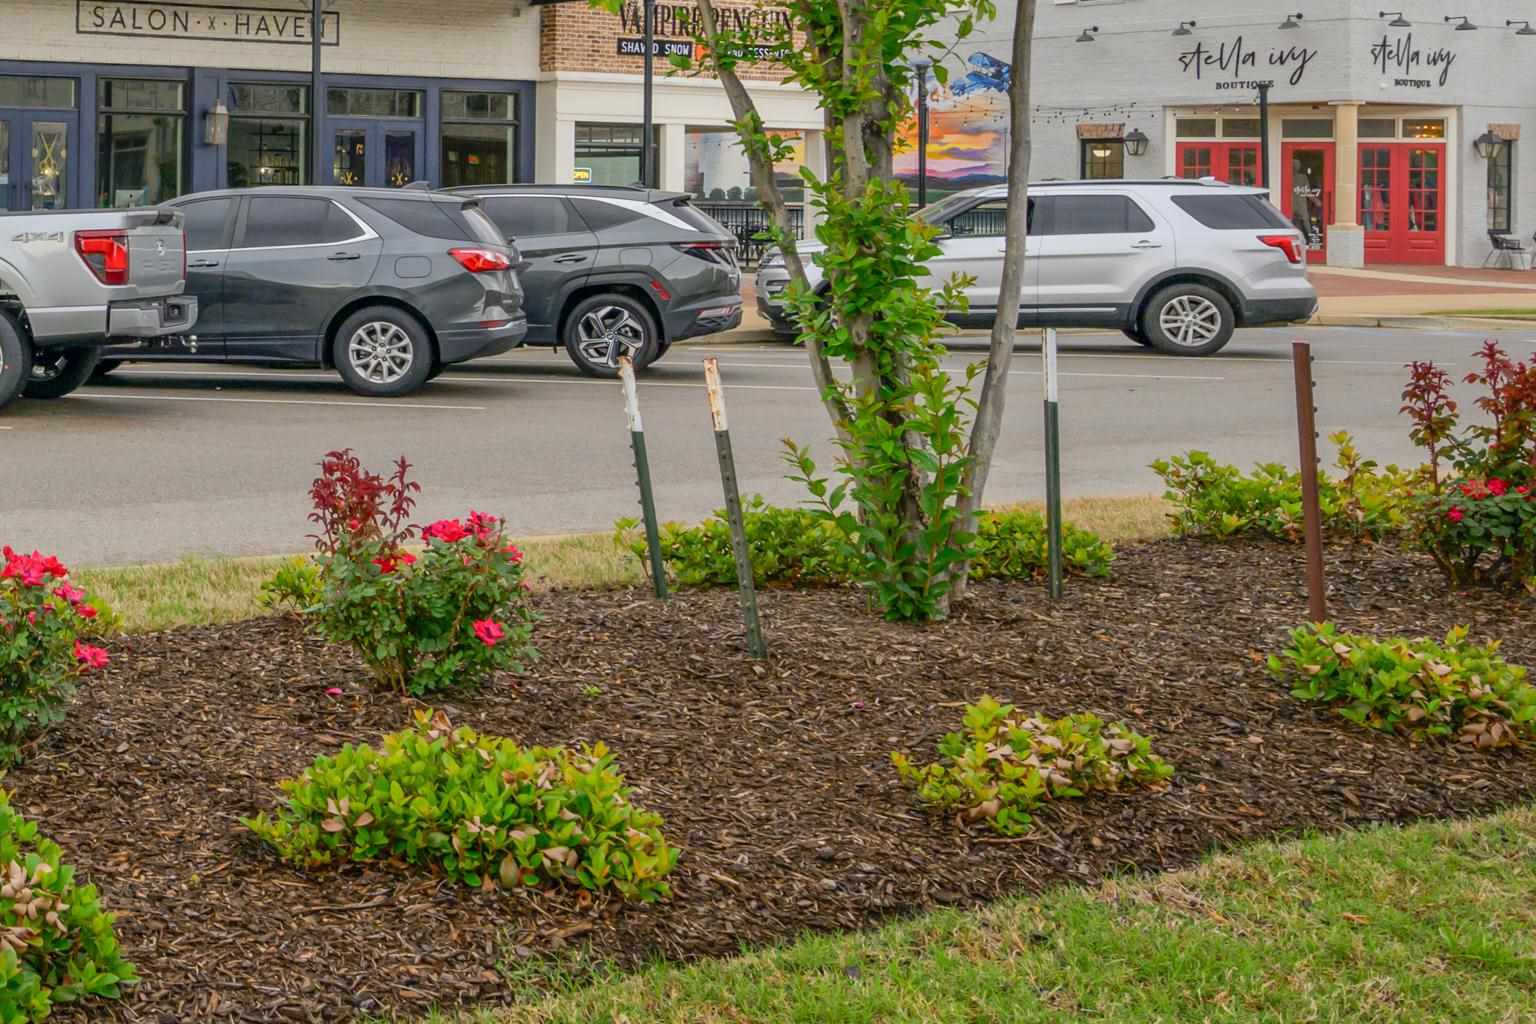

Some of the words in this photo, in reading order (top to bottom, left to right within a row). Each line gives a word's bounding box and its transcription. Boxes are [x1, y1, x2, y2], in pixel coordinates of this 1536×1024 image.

[92, 6, 189, 32] SALON
[621, 41, 659, 54] SHAVD
[664, 43, 690, 56] SNOW
[1178, 35, 1255, 80] stella
[1268, 45, 1318, 86] ivy
[1371, 32, 1420, 75] stella
[1427, 47, 1456, 87] ivy
[1394, 79, 1432, 88] BOUTIQUE
